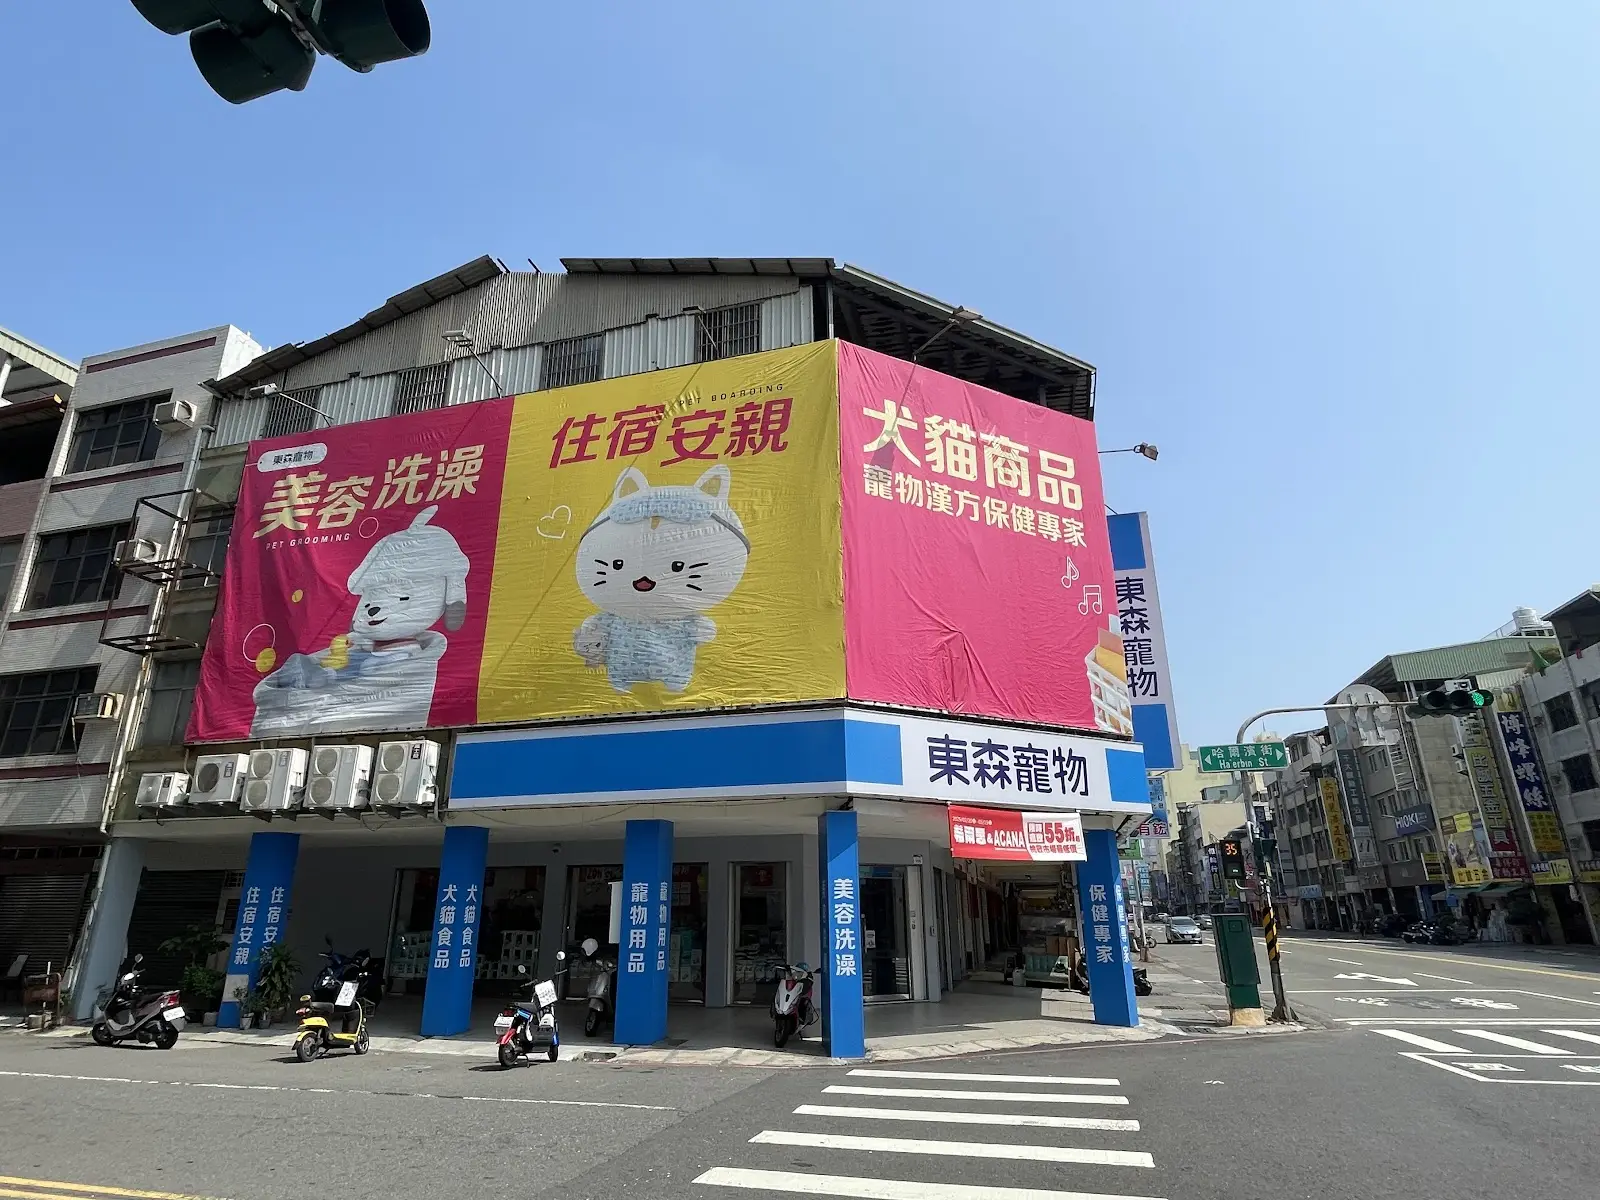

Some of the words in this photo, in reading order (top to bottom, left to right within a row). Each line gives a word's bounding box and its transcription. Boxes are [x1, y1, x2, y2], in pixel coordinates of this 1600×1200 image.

[549, 398, 794, 469] 住宿安親
[678, 397, 702, 407] PET
[711, 383, 785, 402] BOARDING
[252, 444, 485, 539] 美容洗澡
[272, 450, 314, 466] 東森寵物
[862, 399, 1083, 511] 犬貓商品
[266, 539, 285, 550] PET
[289, 532, 351, 547] GROOMING
[863, 463, 1088, 549] 寵物漢方保健專家
[1114, 576, 1159, 698] 東森寵物
[926, 732, 1089, 797] 東森寵物
[1211, 744, 1273, 759] 哈爾濱街
[994, 830, 1027, 848] ACANA
[1395, 812, 1419, 829] HIOKI
[234, 886, 261, 965] 住宿安親
[434, 884, 458, 969] 犬貓食品
[459, 884, 478, 968] 犬貓食品
[628, 882, 649, 973] 寵物用品
[656, 881, 668, 972] 寵物用品
[833, 878, 857, 977] 美容洗澡
[1088, 884, 1115, 964] 保健專家
